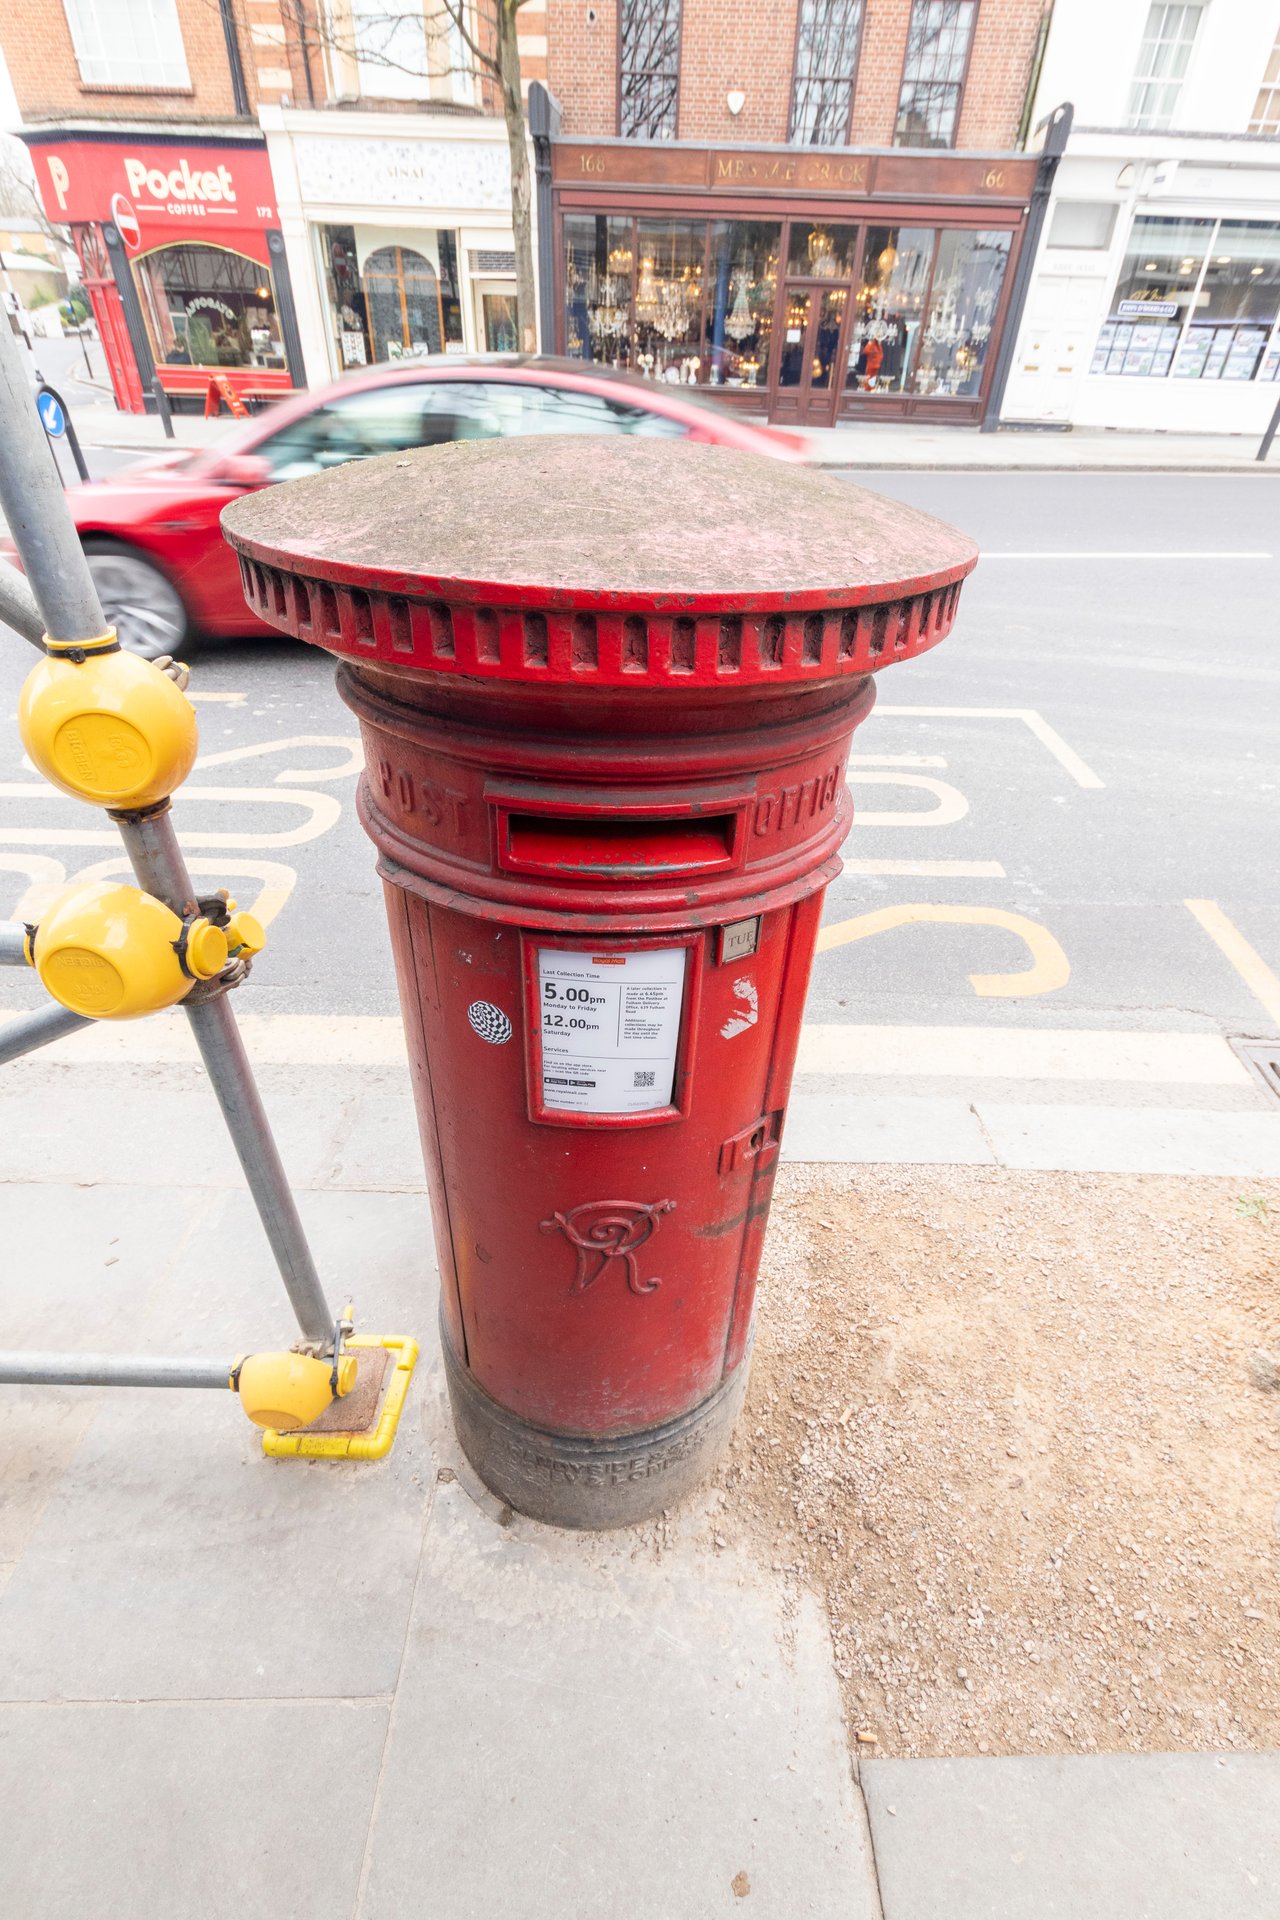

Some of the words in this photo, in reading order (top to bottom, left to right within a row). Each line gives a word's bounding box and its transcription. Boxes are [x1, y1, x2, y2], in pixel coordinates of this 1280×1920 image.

[580, 154, 606, 173] 168
[47, 155, 69, 210] P
[124, 158, 236, 202] Pocket
[167, 202, 206, 216] COFFEE
[380, 759, 467, 836] POST
[727, 930, 754, 948] TUE
[556, 970, 585, 978] Collection
[544, 982, 606, 1004] 5.00pm
[543, 1002, 568, 1010] Monday
[543, 1014, 600, 1031] 12.00pm
[543, 1029, 571, 1037] Saturday
